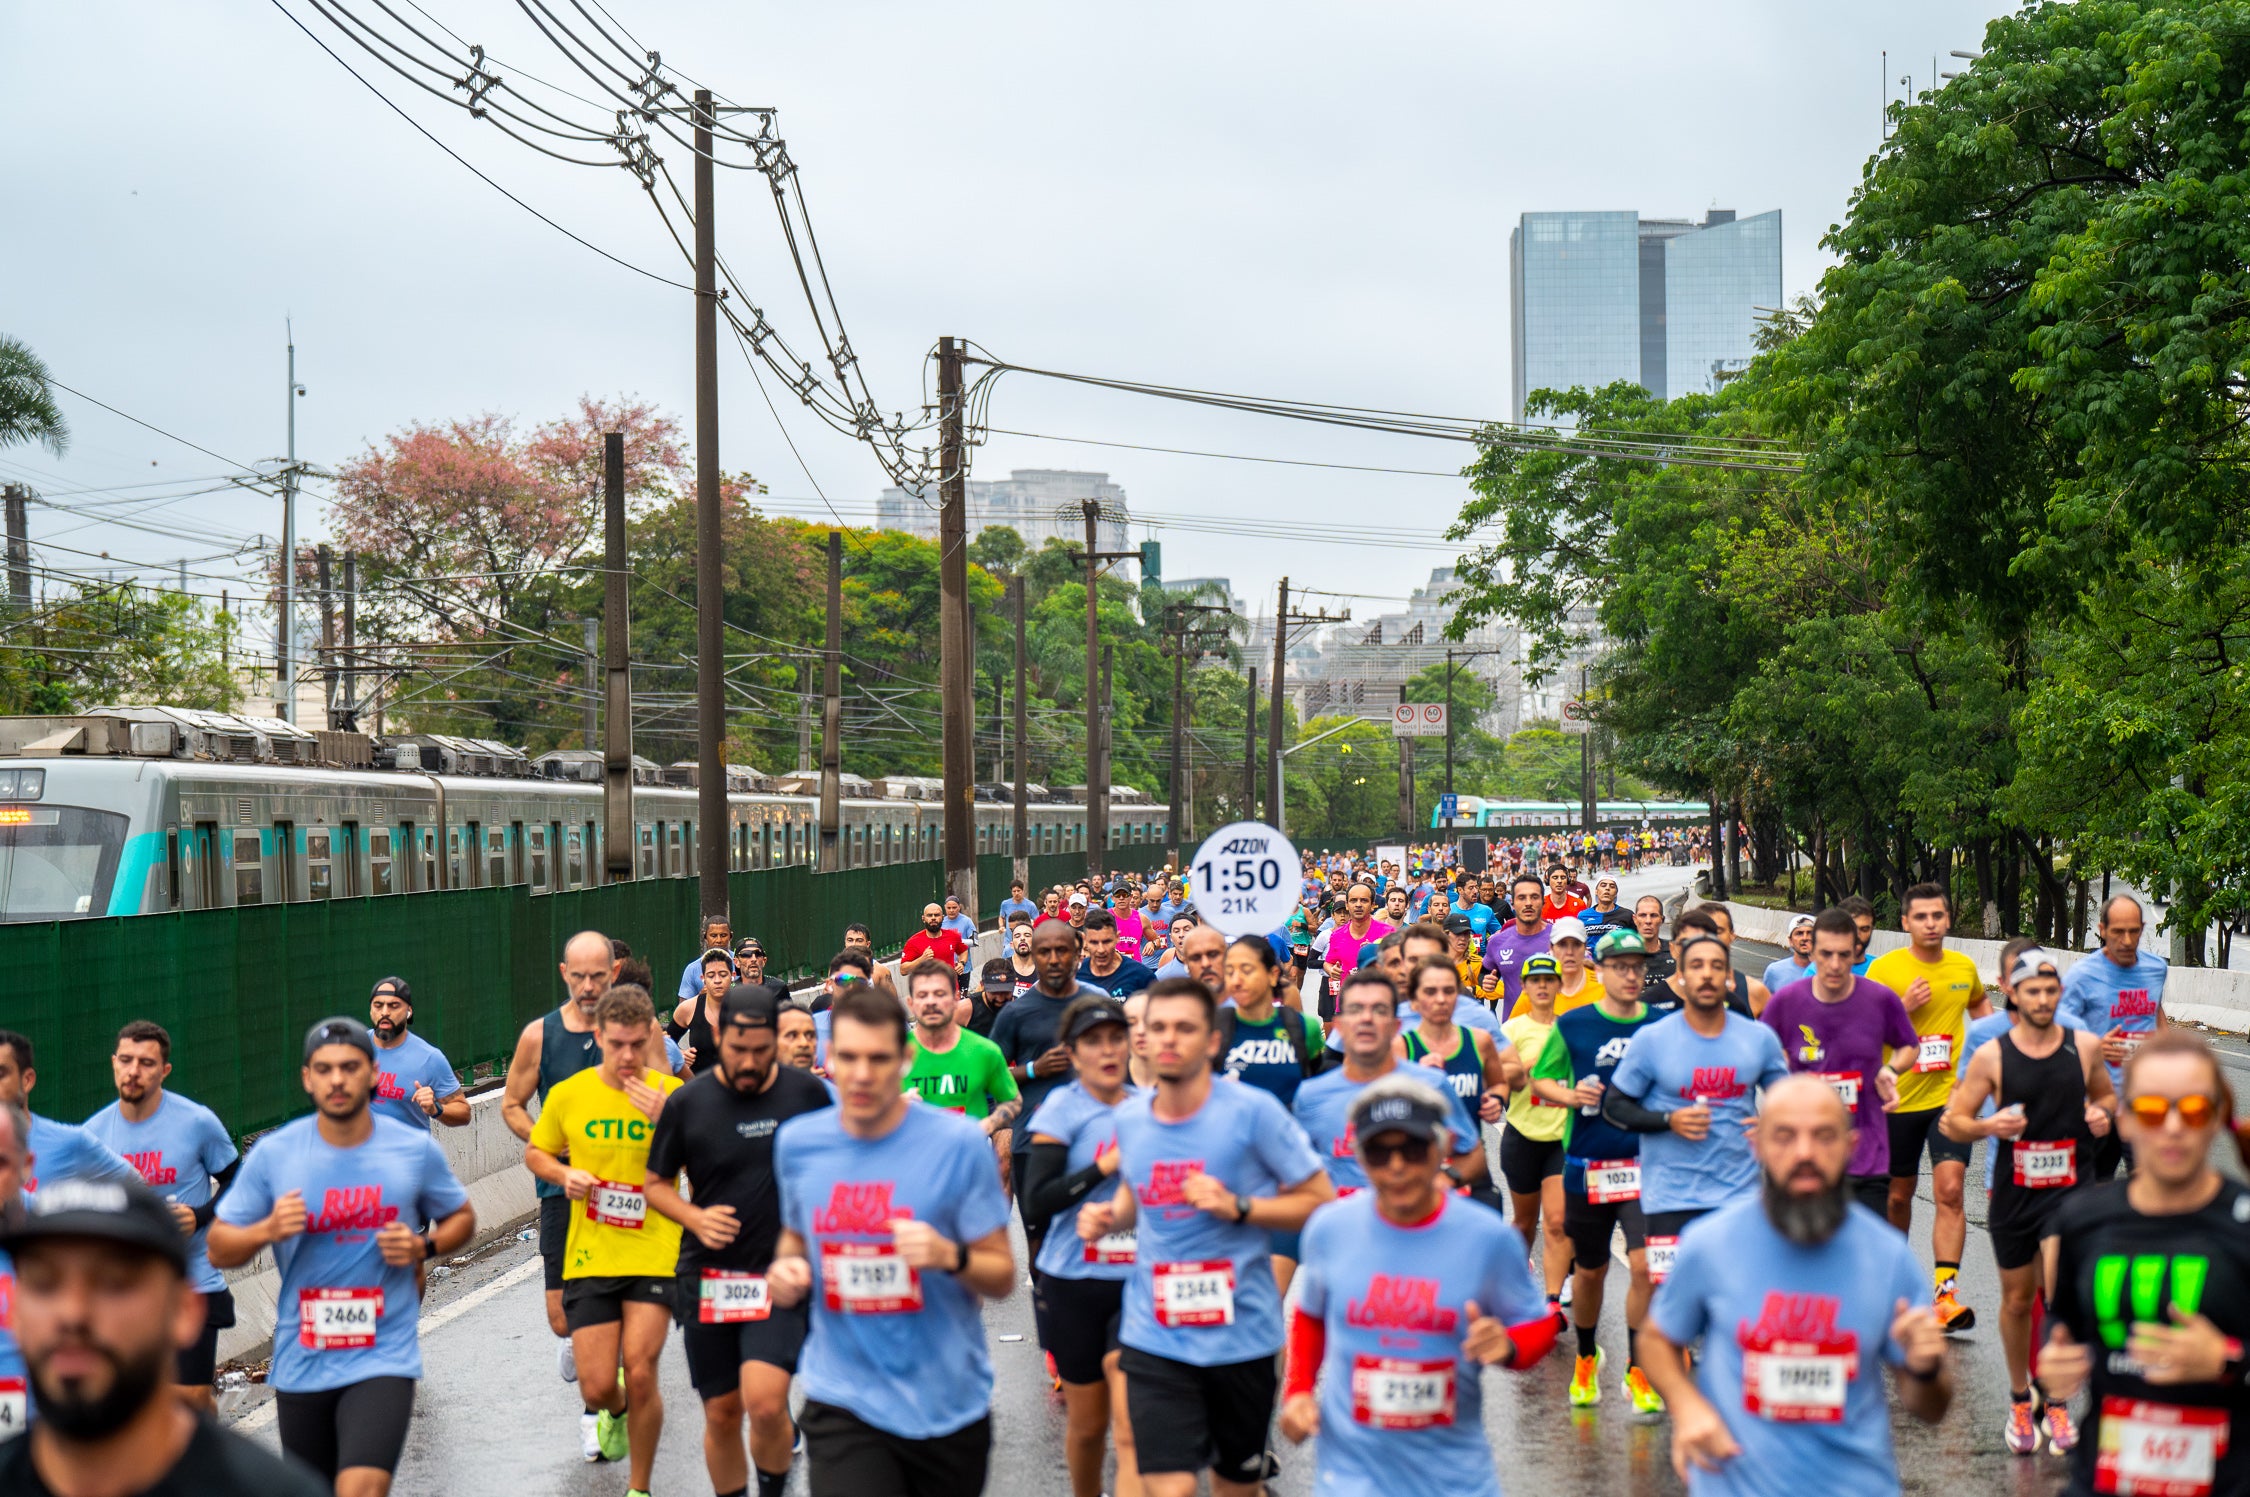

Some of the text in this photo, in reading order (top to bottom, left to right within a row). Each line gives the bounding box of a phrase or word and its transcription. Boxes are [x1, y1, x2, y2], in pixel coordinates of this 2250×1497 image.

[1400, 708, 1411, 716] 90
[1428, 708, 1438, 716] 60
[1220, 837, 1270, 855] AZON
[1197, 859, 1280, 892] 1:50
[1221, 897, 1258, 914] 21K
[2118, 988, 2148, 1003] RUN
[2110, 1001, 2156, 1018] LONGER
[1225, 1039, 1296, 1064] AZON
[911, 1074, 968, 1095] TITAN
[1692, 1066, 1736, 1087] RUN
[1607, 1172, 1635, 1184] 1023
[324, 1184, 382, 1213] RUN
[607, 1194, 642, 1212] 2340
[829, 1181, 895, 1211] RUN
[724, 1284, 760, 1300] 3026
[1368, 1273, 1440, 1307] RUN
[324, 1306, 368, 1324] 2466
[1761, 1290, 1841, 1327] RUN
